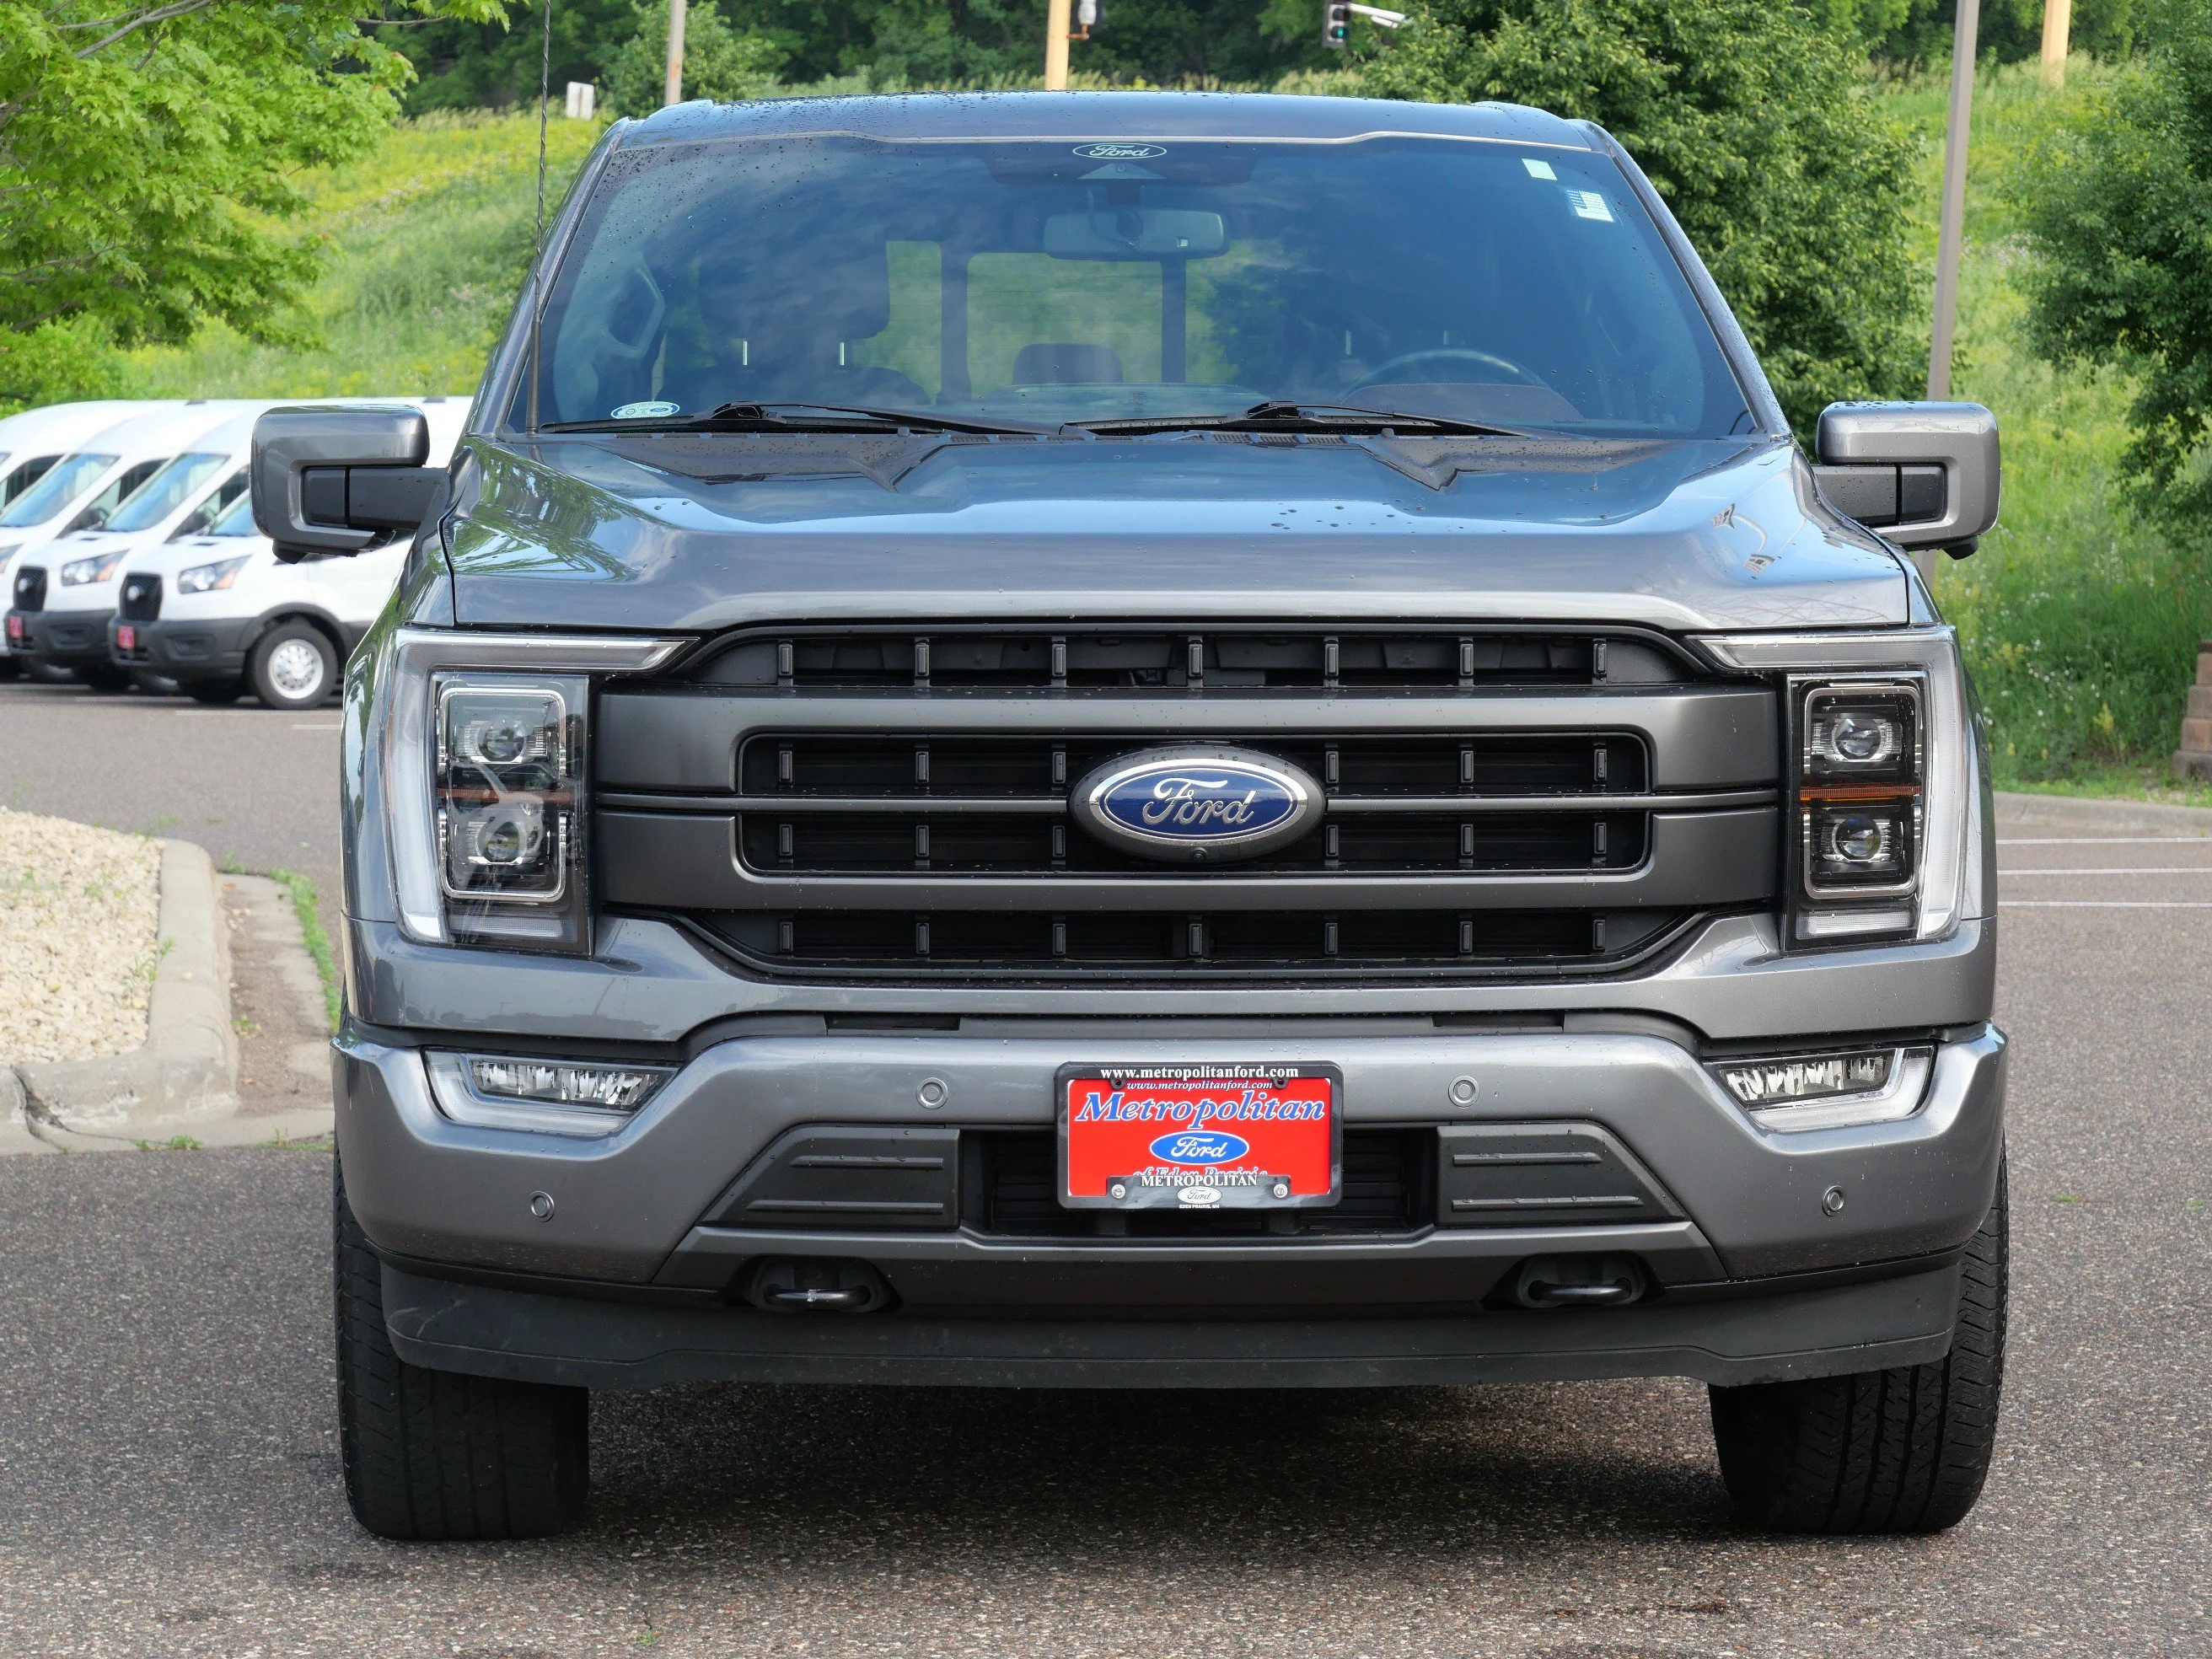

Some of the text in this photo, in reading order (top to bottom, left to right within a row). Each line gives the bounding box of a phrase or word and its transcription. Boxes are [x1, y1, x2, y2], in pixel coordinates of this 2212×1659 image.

[1089, 144, 1150, 157] Ford
[1142, 777, 1257, 824] Ford
[1100, 1066, 1299, 1082] www.metropolitanford.com
[1126, 1080, 1273, 1092] www.metropolitanford.com
[1075, 1090, 1325, 1130] Metropolitan
[1170, 1136, 1227, 1158] Ford
[1141, 1174, 1258, 1187] METROPOLITAN
[1187, 1189, 1212, 1200] Ford
